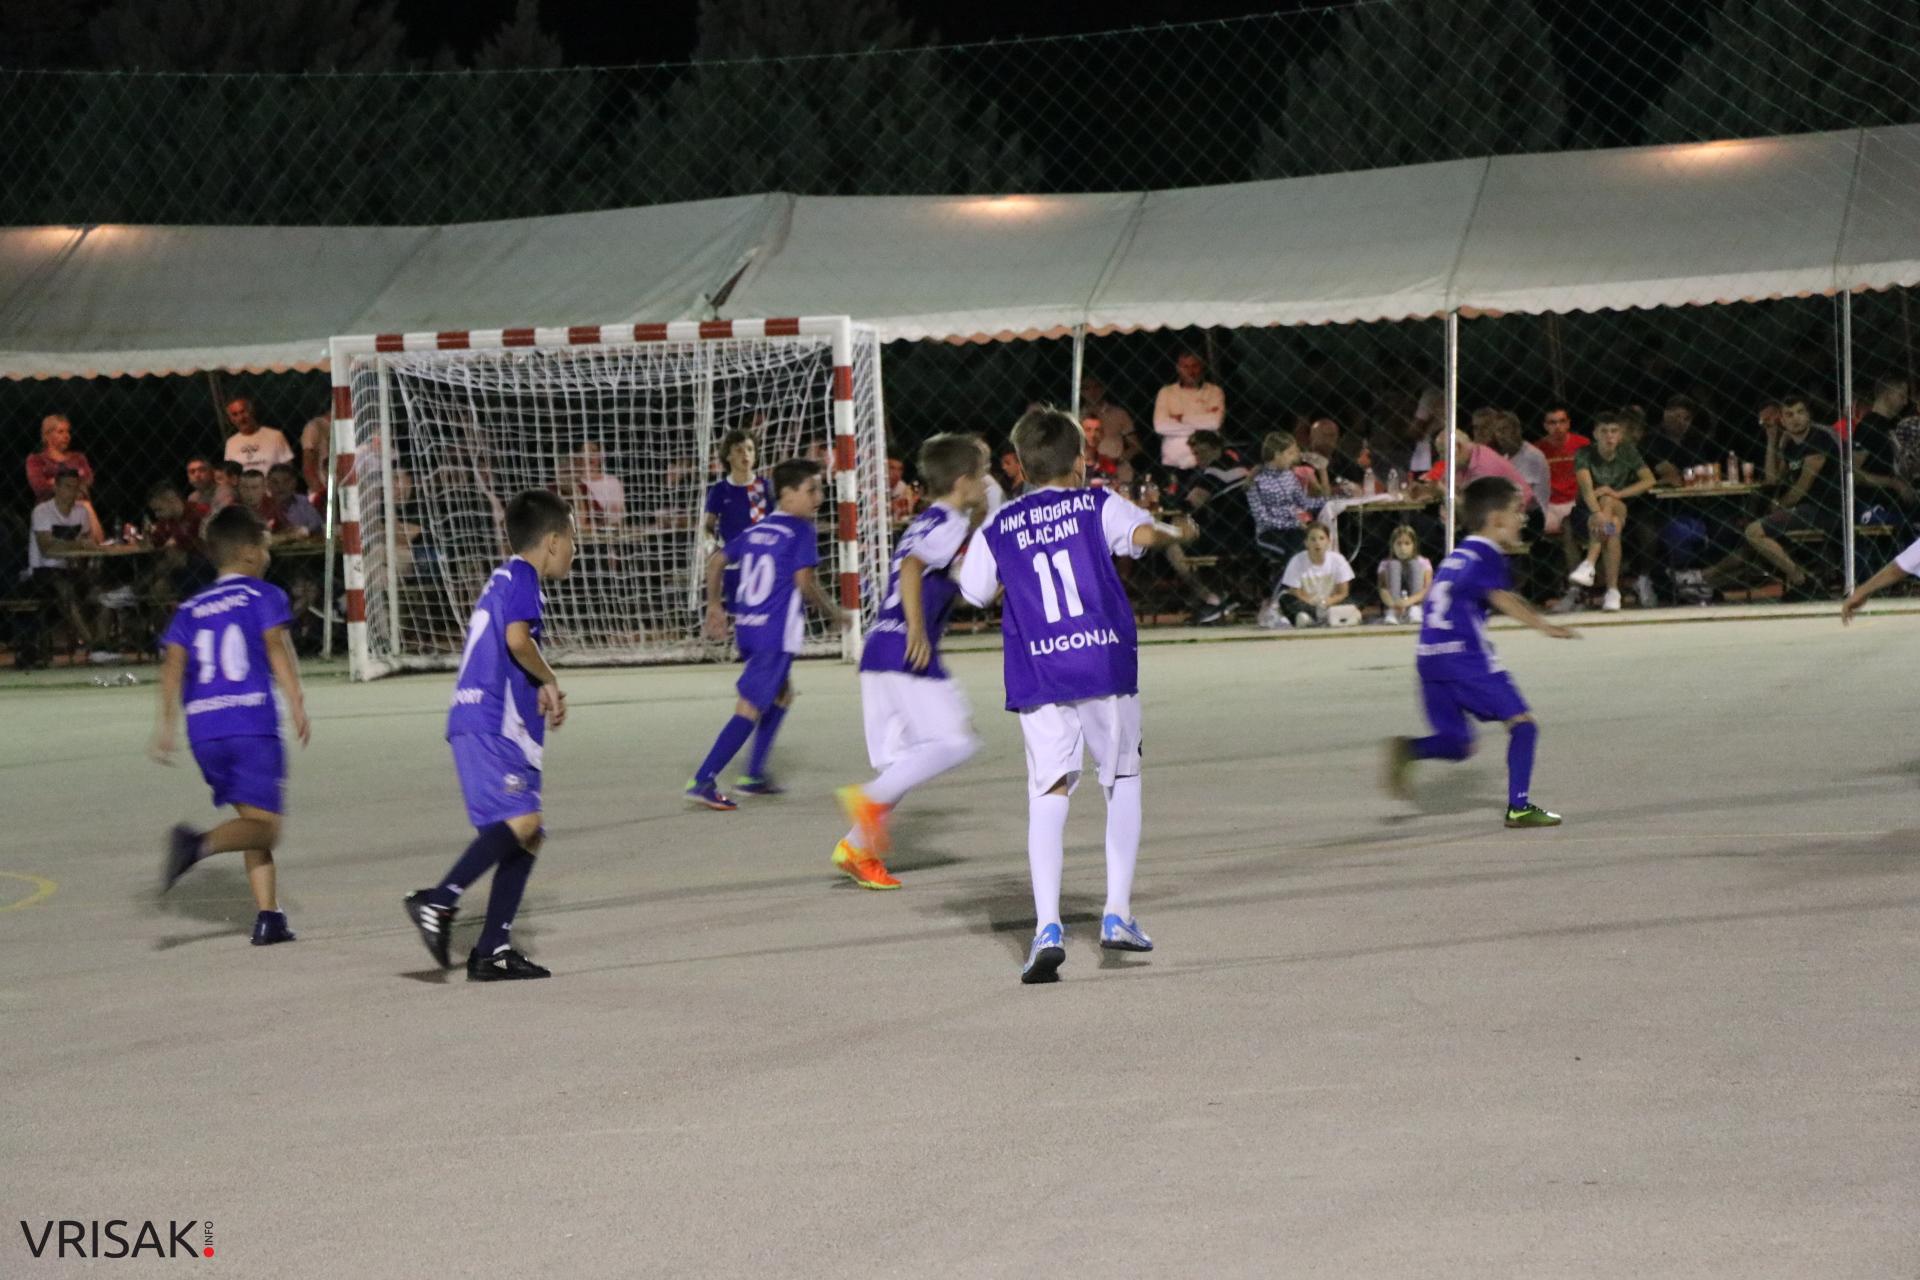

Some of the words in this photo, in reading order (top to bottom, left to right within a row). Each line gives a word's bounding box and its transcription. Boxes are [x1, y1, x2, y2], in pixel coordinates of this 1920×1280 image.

[1000, 511, 1026, 534] HNK
[735, 552, 776, 607] 10
[1033, 549, 1084, 623] 11
[192, 623, 250, 684] 10
[1030, 628, 1119, 656] LUGONJA
